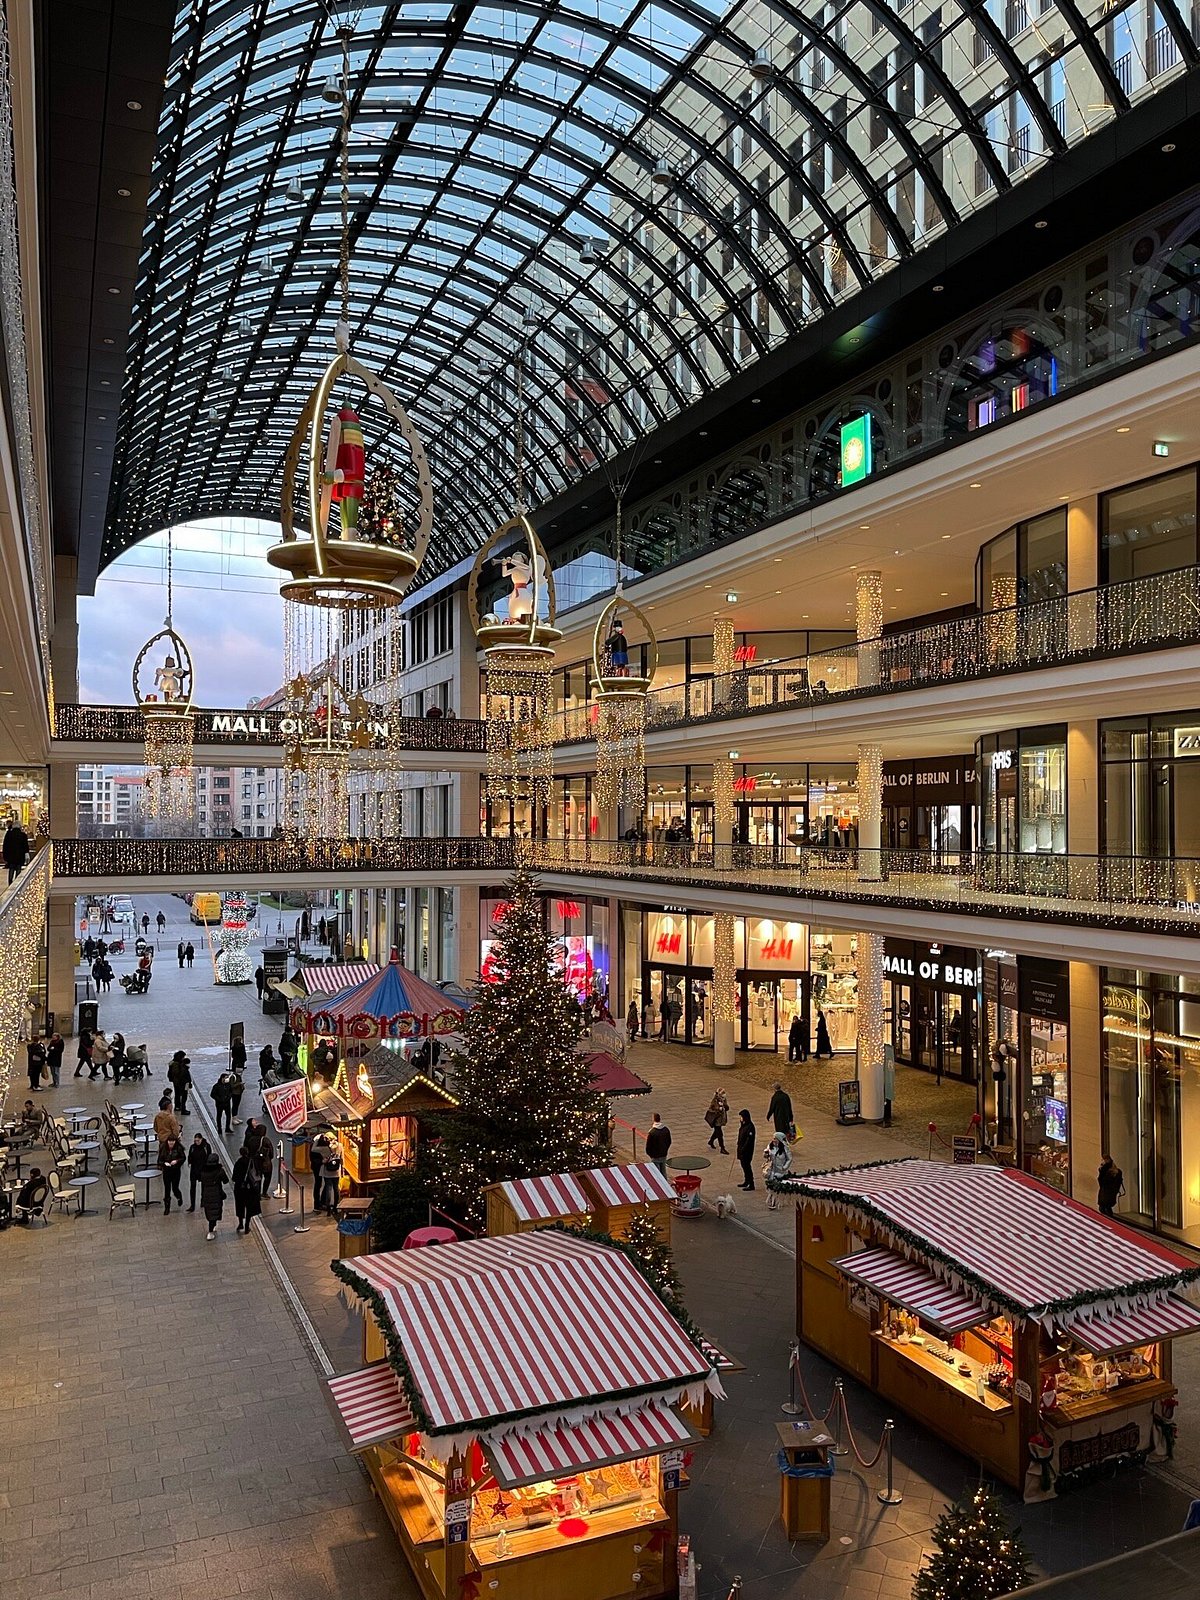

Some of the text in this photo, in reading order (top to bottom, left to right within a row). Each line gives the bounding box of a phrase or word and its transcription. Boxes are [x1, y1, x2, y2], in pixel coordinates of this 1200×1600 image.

[212, 715, 270, 733] MALL
[899, 773, 913, 786] OF
[916, 770, 950, 785] BERLIN
[656, 933, 682, 955] H&M
[760, 938, 794, 961] H&M
[882, 954, 915, 976] MALL
[919, 961, 939, 980] OF
